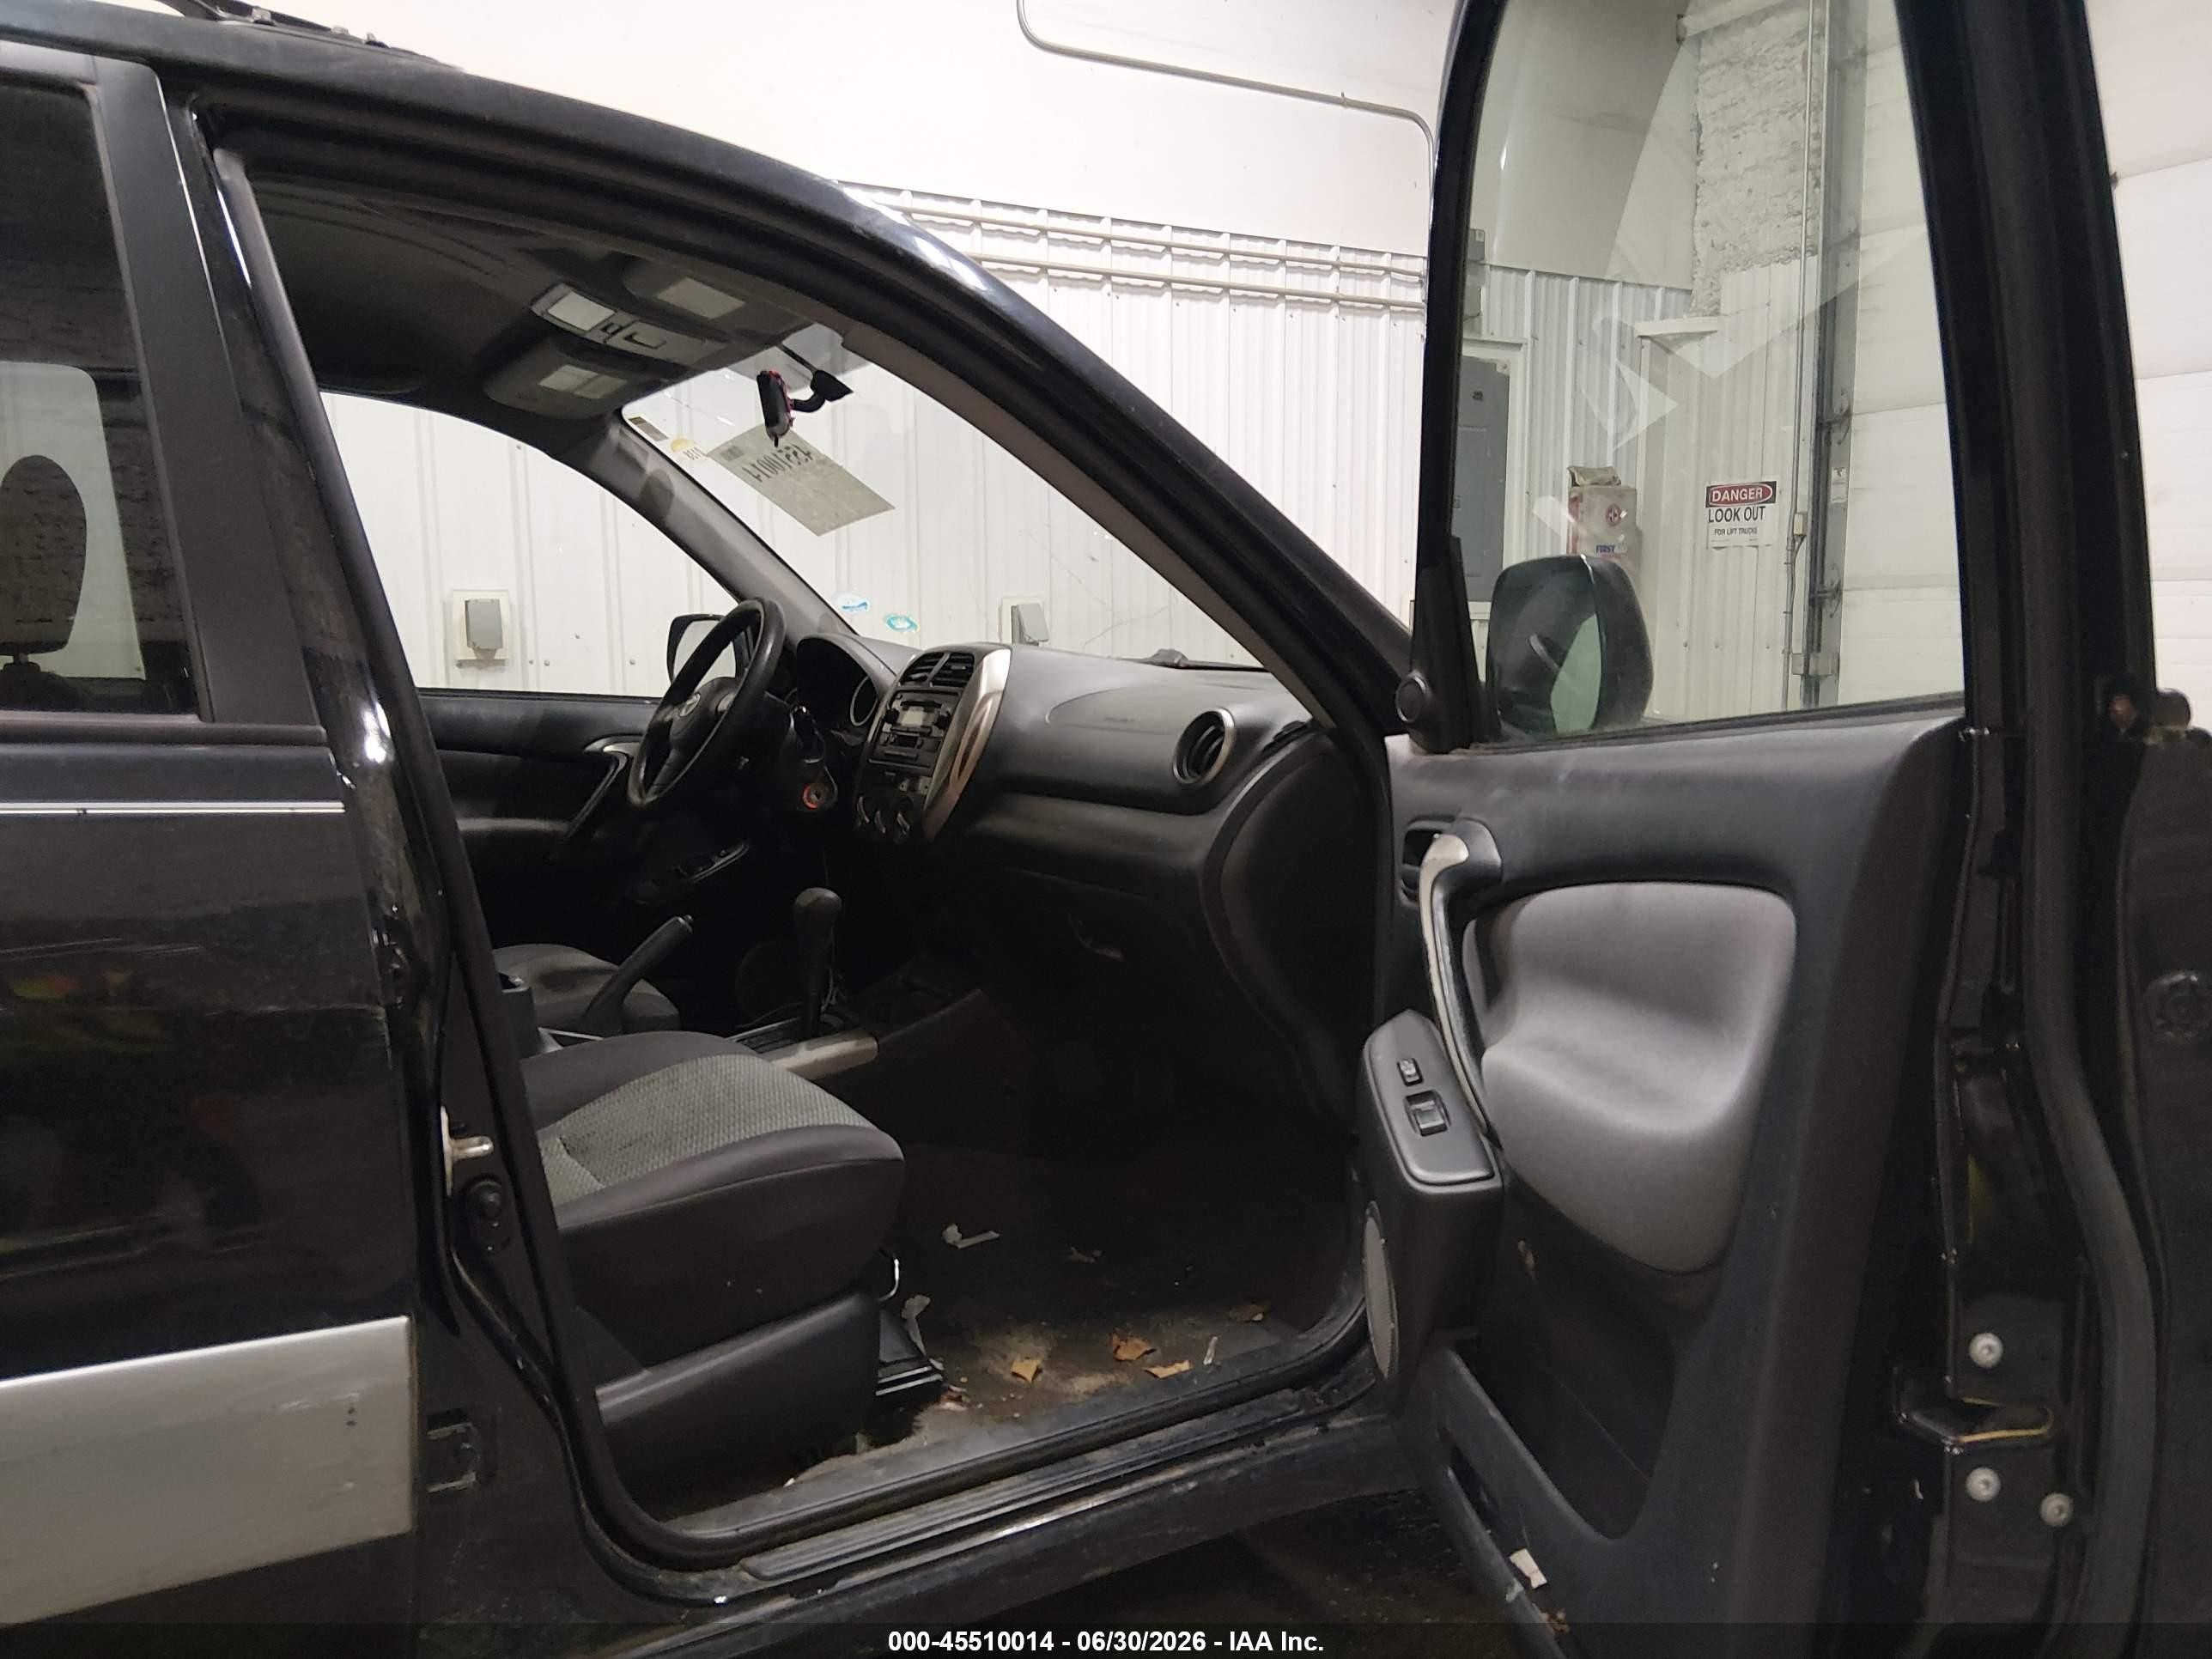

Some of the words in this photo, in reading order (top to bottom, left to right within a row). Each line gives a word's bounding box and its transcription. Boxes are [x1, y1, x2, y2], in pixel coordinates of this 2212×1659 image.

[1712, 487, 1763, 502] DANGER
[1709, 507, 1741, 523] LOOK
[1744, 507, 1765, 521] OUT
[1727, 527, 1737, 536] LIFT
